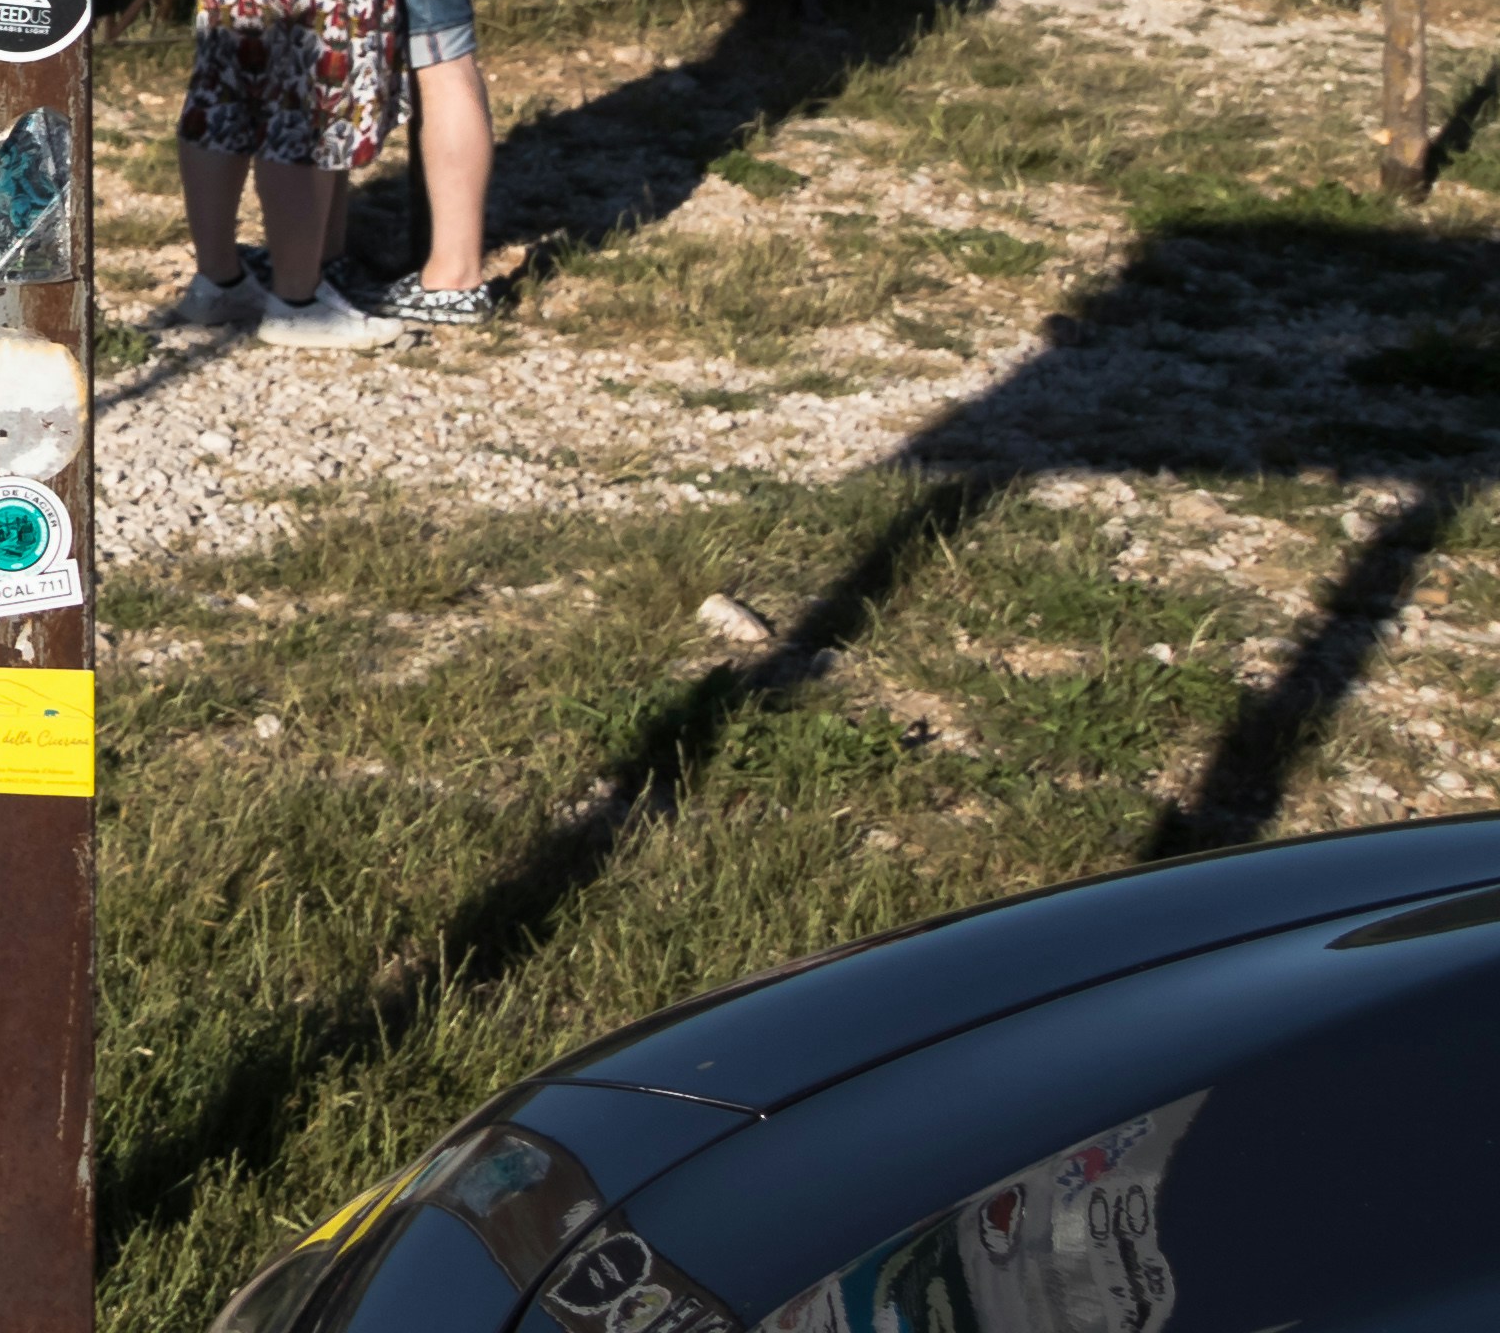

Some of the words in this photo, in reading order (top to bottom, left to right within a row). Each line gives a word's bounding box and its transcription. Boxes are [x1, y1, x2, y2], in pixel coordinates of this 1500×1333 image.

[24, 490, 58, 529] L'ACIER
[39, 579, 65, 592] 711
[3, 730, 32, 745] della
